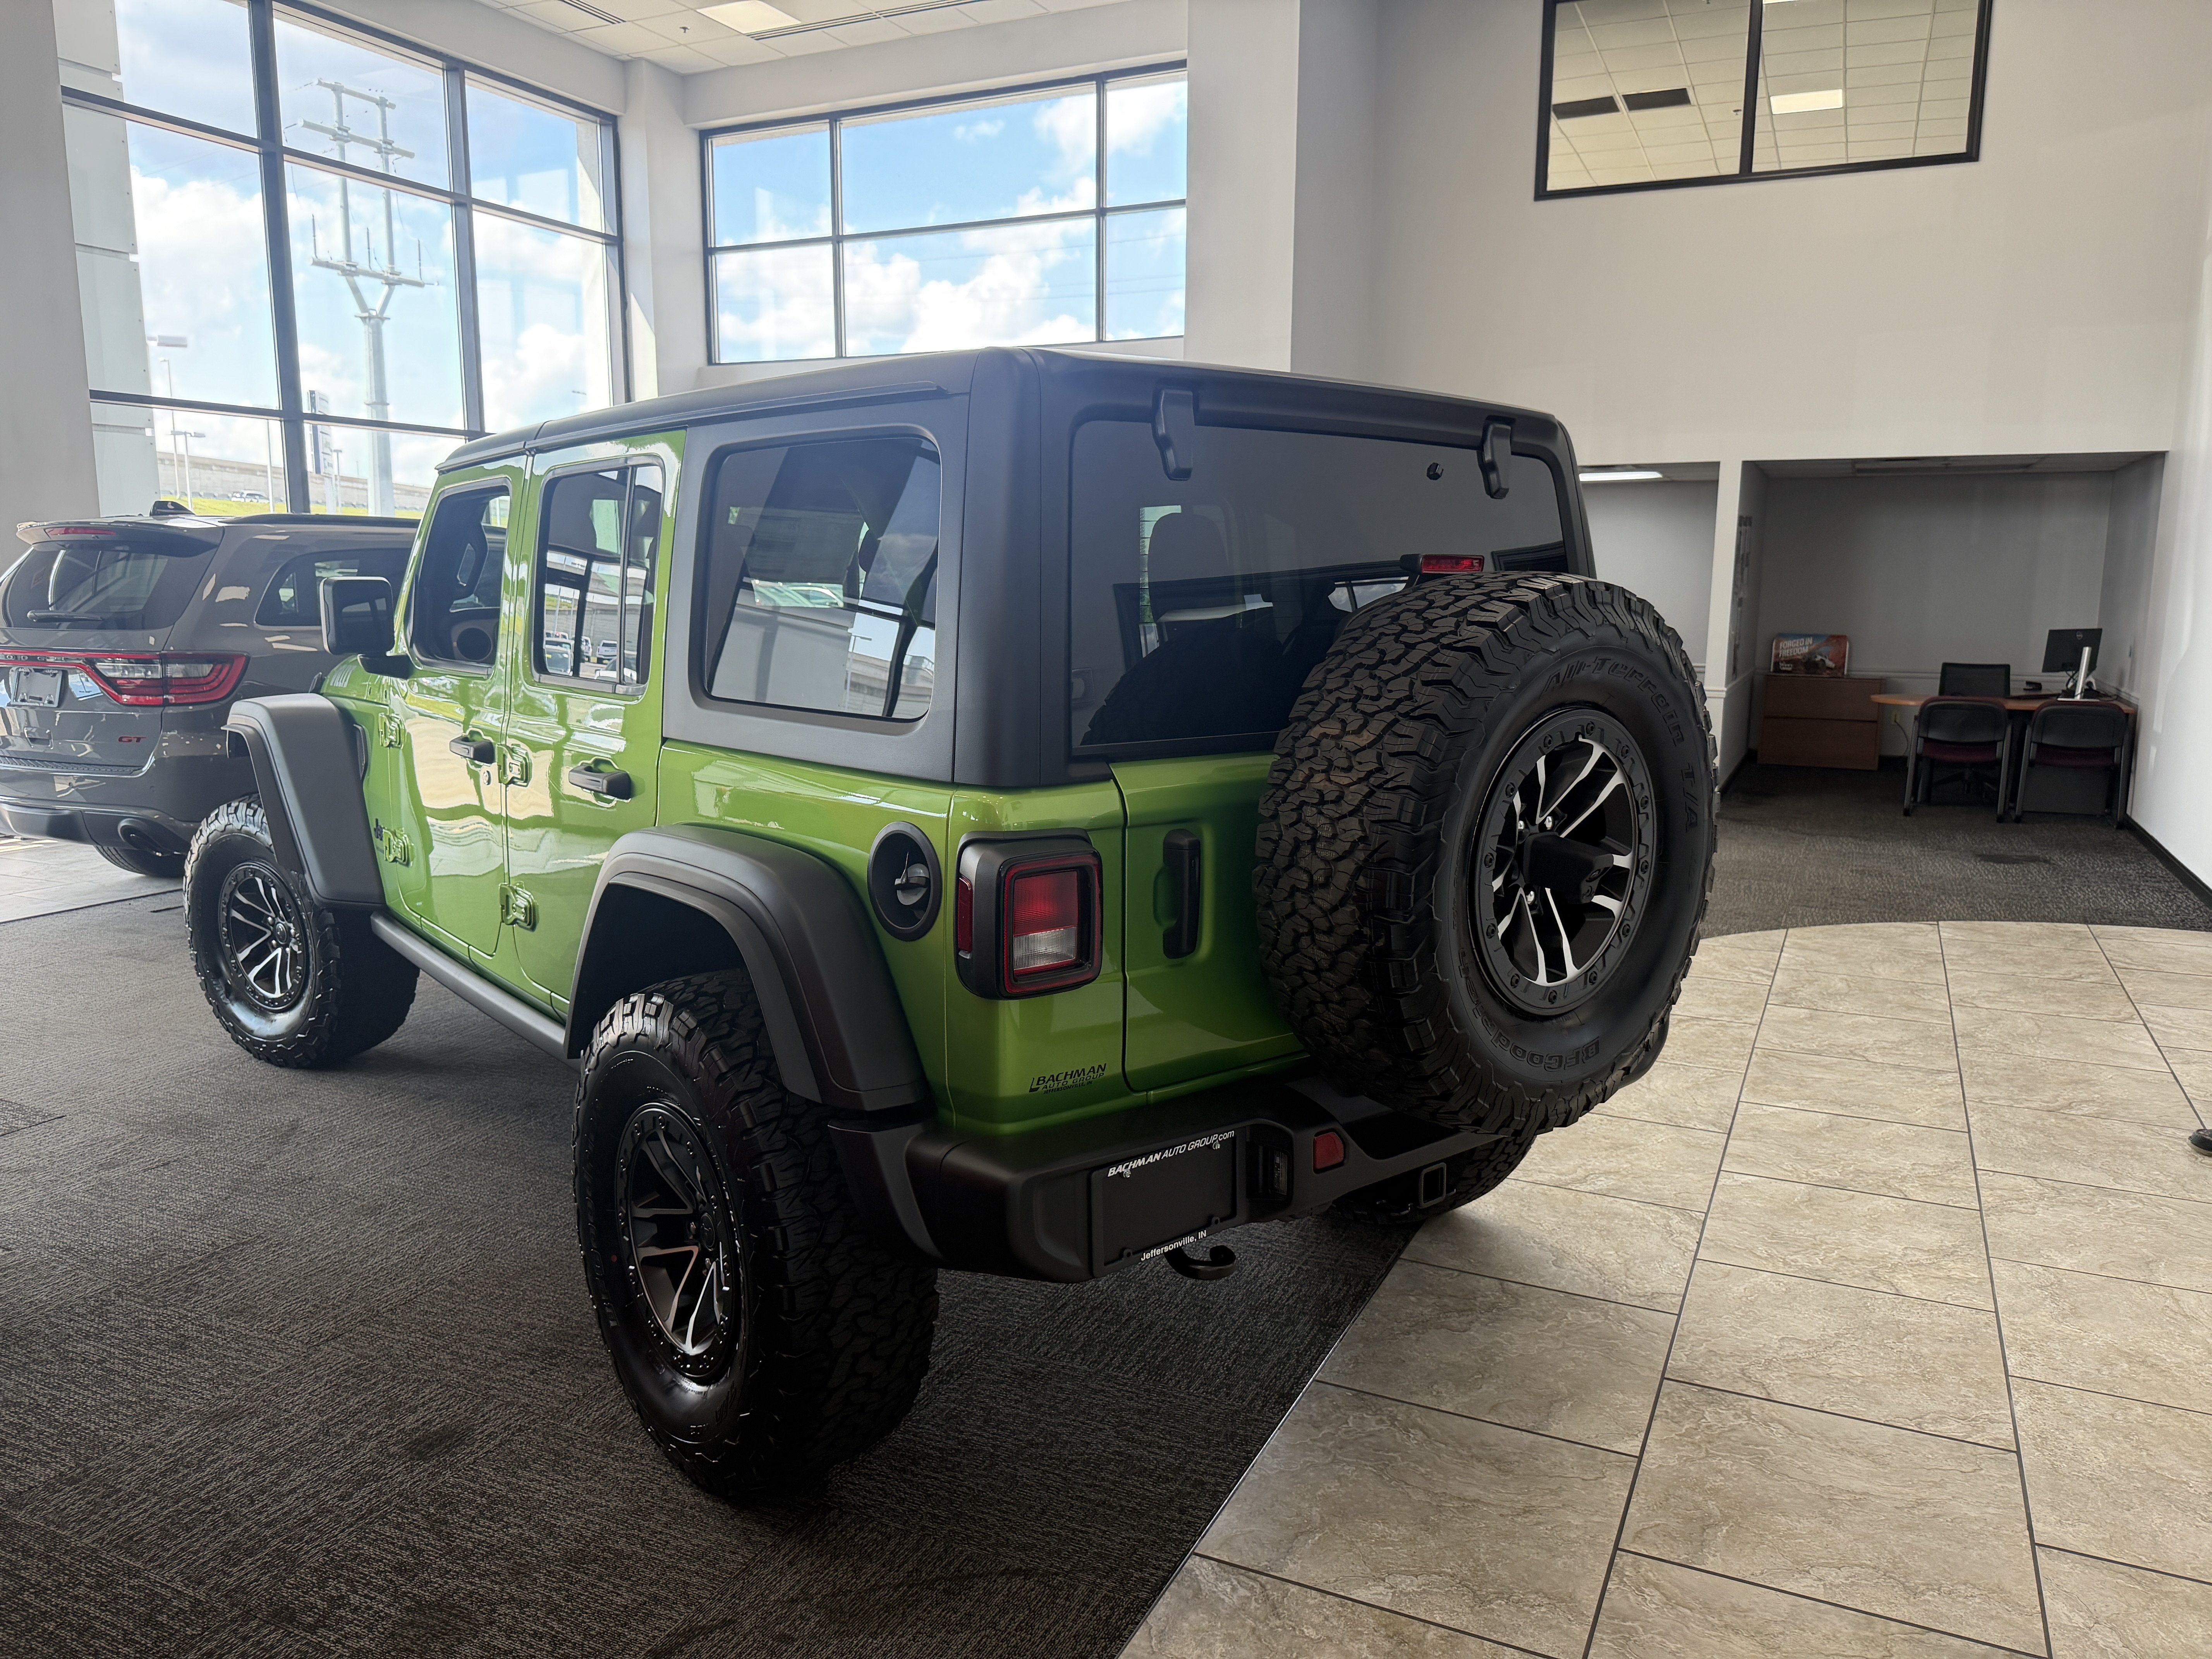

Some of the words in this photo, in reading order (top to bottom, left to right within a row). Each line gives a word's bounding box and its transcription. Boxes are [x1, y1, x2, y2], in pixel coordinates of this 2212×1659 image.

[1779, 638, 1805, 649] FORGED
[1805, 636, 1813, 645] IN
[1779, 646, 1808, 657] FREEDOM
[1458, 948, 1600, 1072] BFGoodrich
[1036, 1063, 1107, 1086] BACHMAN
[1042, 1080, 1068, 1090] AUTO
[1072, 1073, 1104, 1084] GROUP
[1043, 1082, 1085, 1094] JEFFERSONVILLE,
[1108, 1152, 1161, 1177] BACHMAN
[1161, 1144, 1187, 1159] AUTO
[1141, 1236, 1197, 1261] Jeffersonville,
[1198, 1230, 1207, 1239] IN
